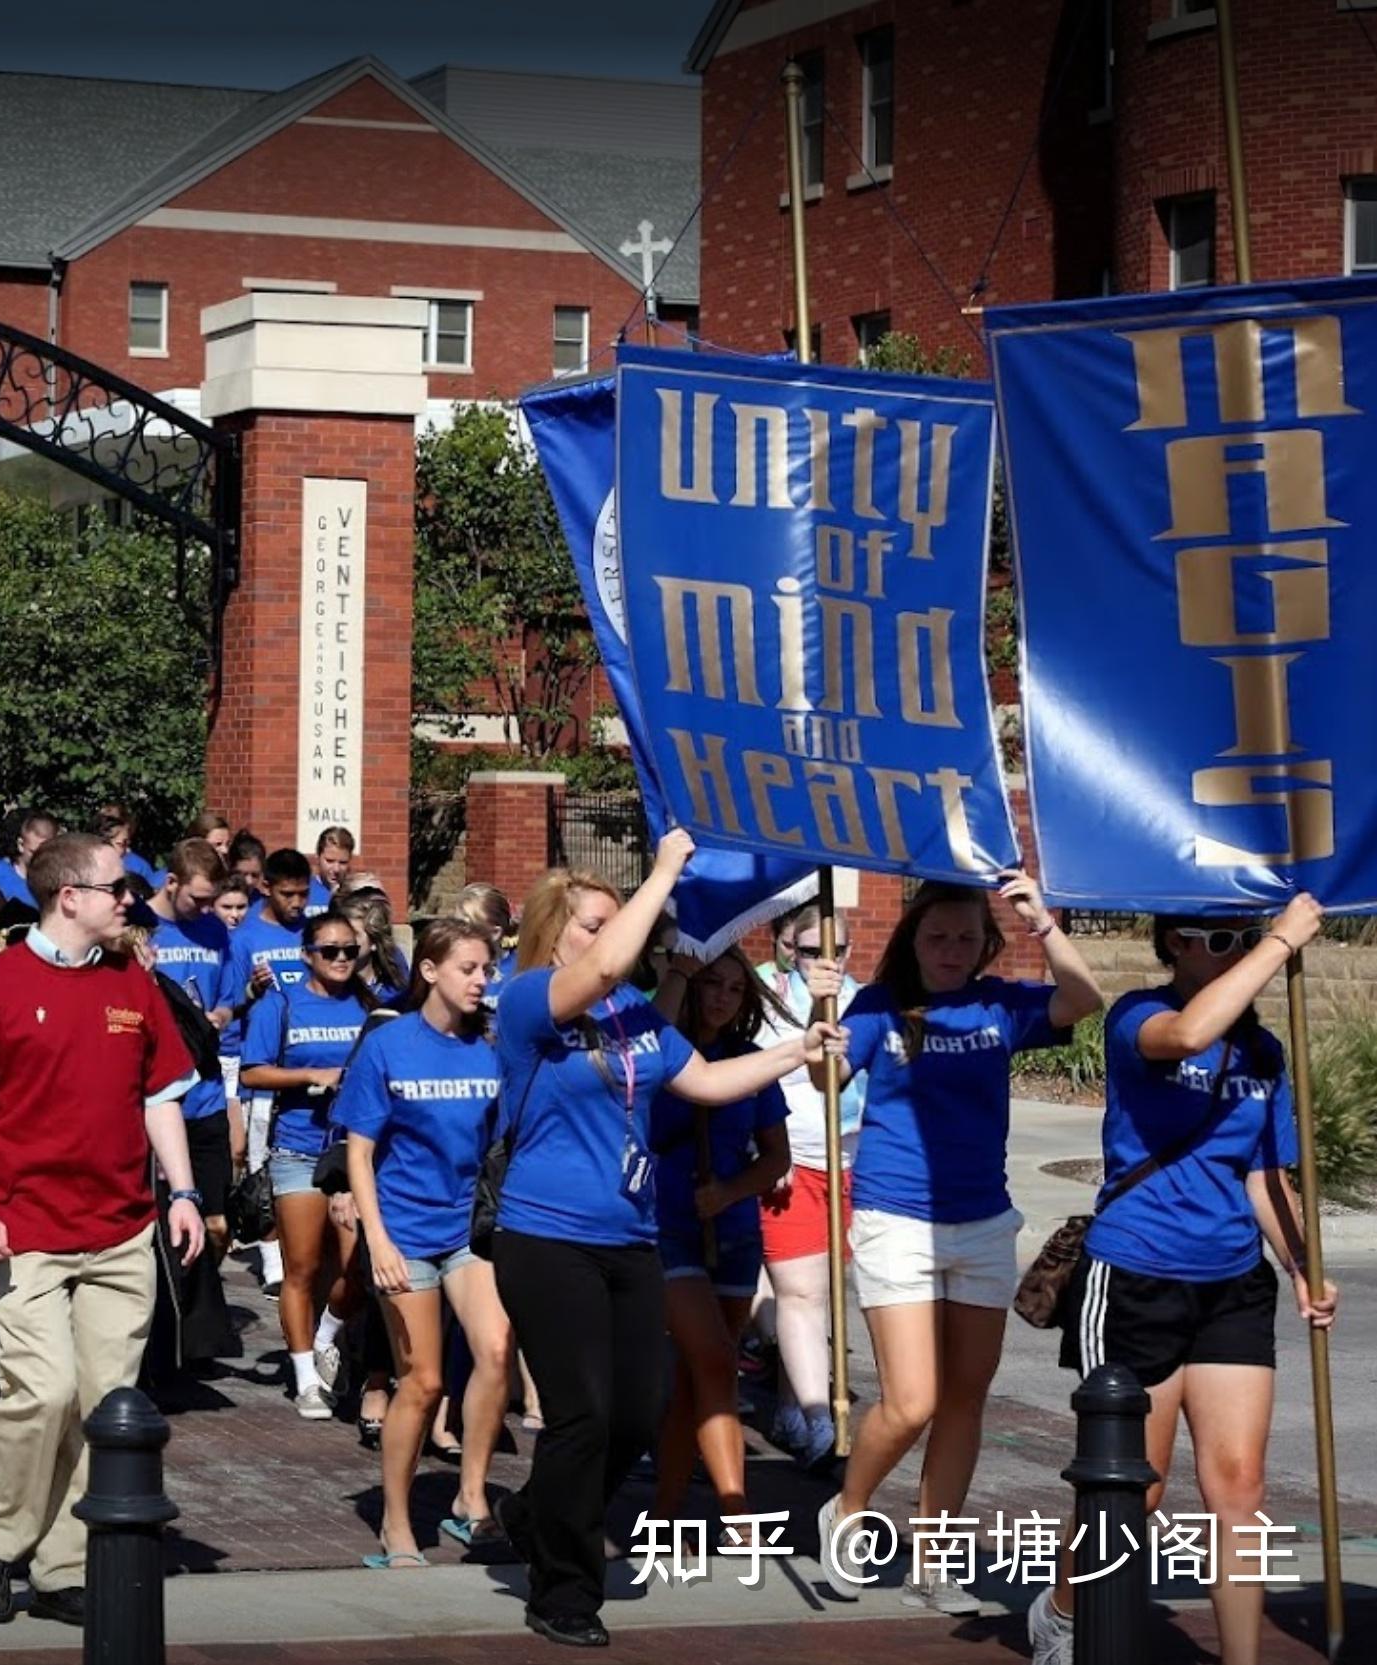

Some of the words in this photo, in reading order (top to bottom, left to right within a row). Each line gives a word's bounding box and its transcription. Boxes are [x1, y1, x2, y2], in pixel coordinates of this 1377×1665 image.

[314, 515, 327, 638] GEORGE
[815, 523, 899, 600] of
[1113, 314, 1365, 867] MAGIS
[332, 506, 352, 787] VENTEICHER
[312, 680, 325, 781] SUSAN
[780, 712, 865, 765] and
[307, 807, 350, 823] MALL
[665, 727, 1000, 874] Heart
[389, 1078, 501, 1101] CREIGHTO
